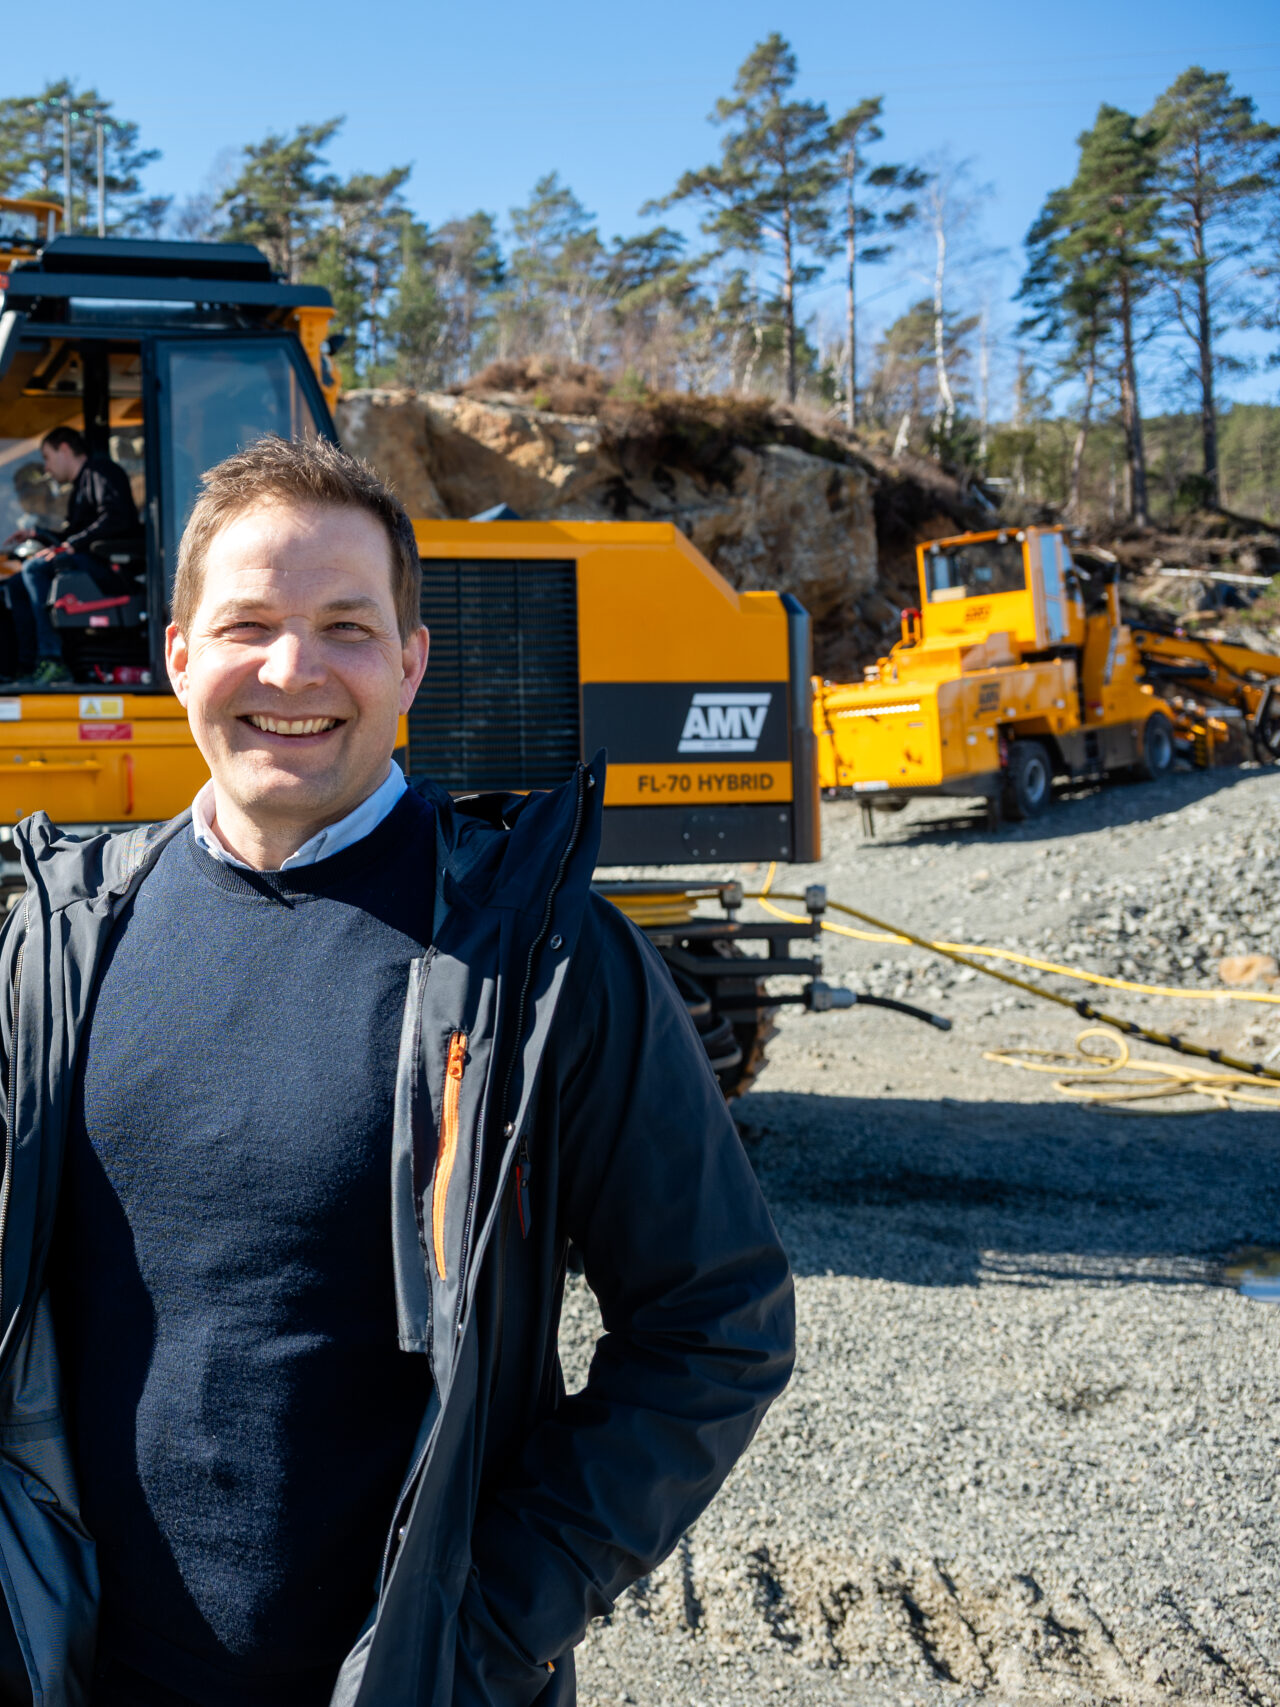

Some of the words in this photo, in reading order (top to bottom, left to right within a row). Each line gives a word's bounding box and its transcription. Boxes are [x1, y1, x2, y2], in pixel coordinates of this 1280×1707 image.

[681, 706, 768, 738] AMV
[638, 775, 691, 792] FL-70
[698, 773, 774, 791] HYBRID
